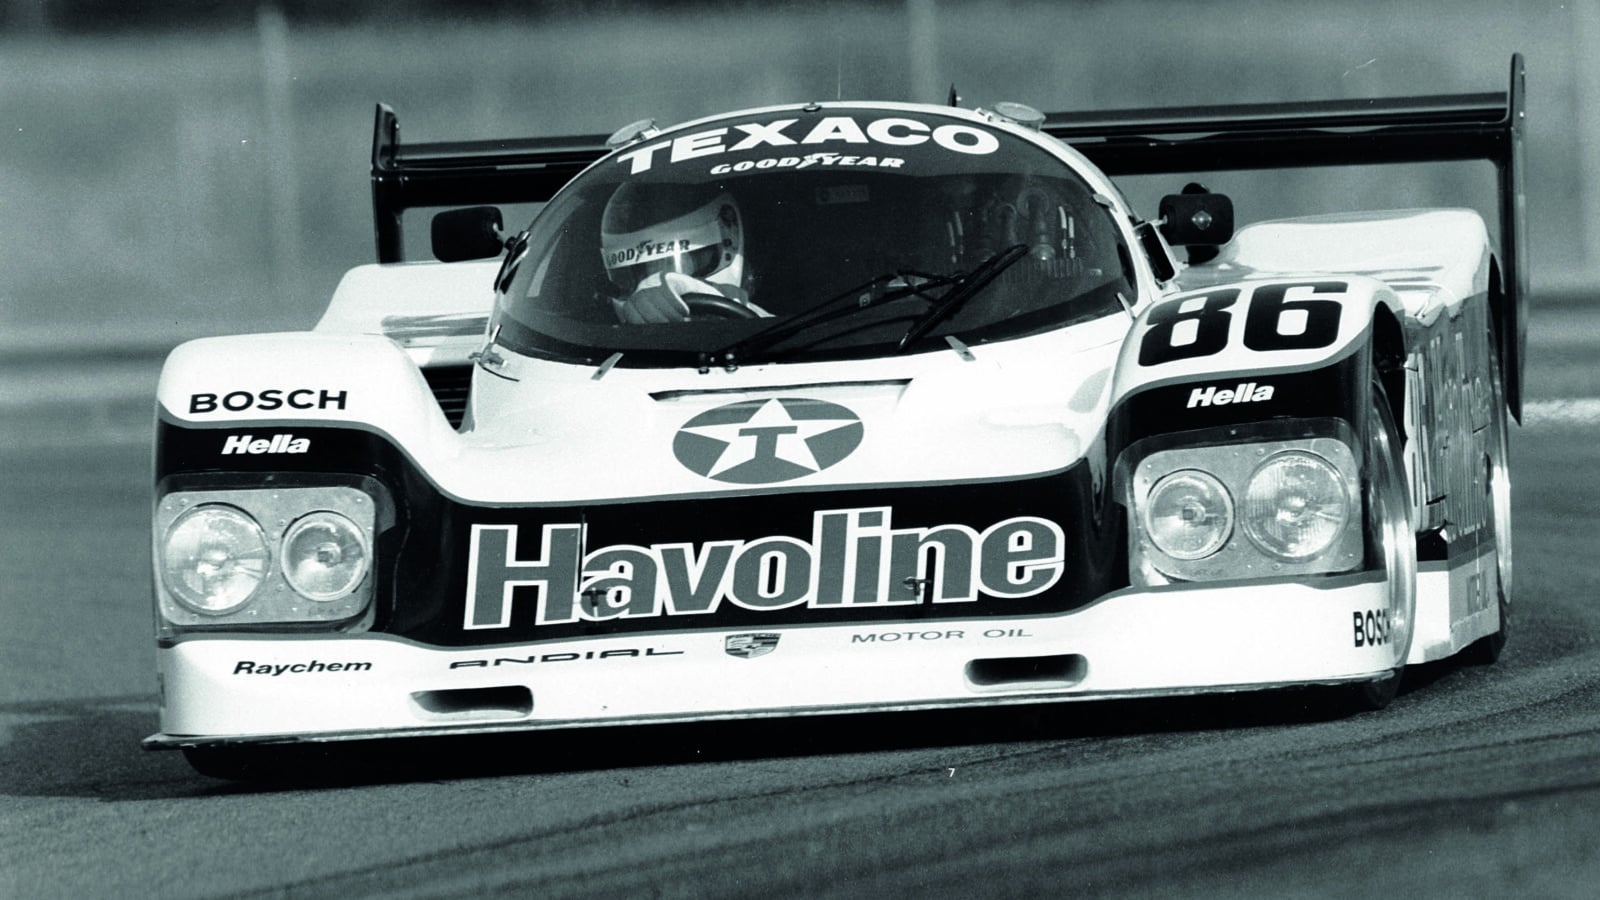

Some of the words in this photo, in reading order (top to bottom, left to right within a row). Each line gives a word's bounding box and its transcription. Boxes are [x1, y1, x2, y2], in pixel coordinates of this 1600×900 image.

[617, 116, 999, 174] TEXACO
[1138, 281, 1348, 366] 86
[189, 389, 347, 413] BOSCH
[1186, 382, 1274, 408] Hella
[221, 434, 310, 454] Hella
[463, 506, 1065, 631] Havoline
[851, 630, 965, 643] MOTOR
[983, 629, 1032, 638] OIL
[233, 660, 372, 676] Raychem
[449, 648, 684, 669] ANDIAL
